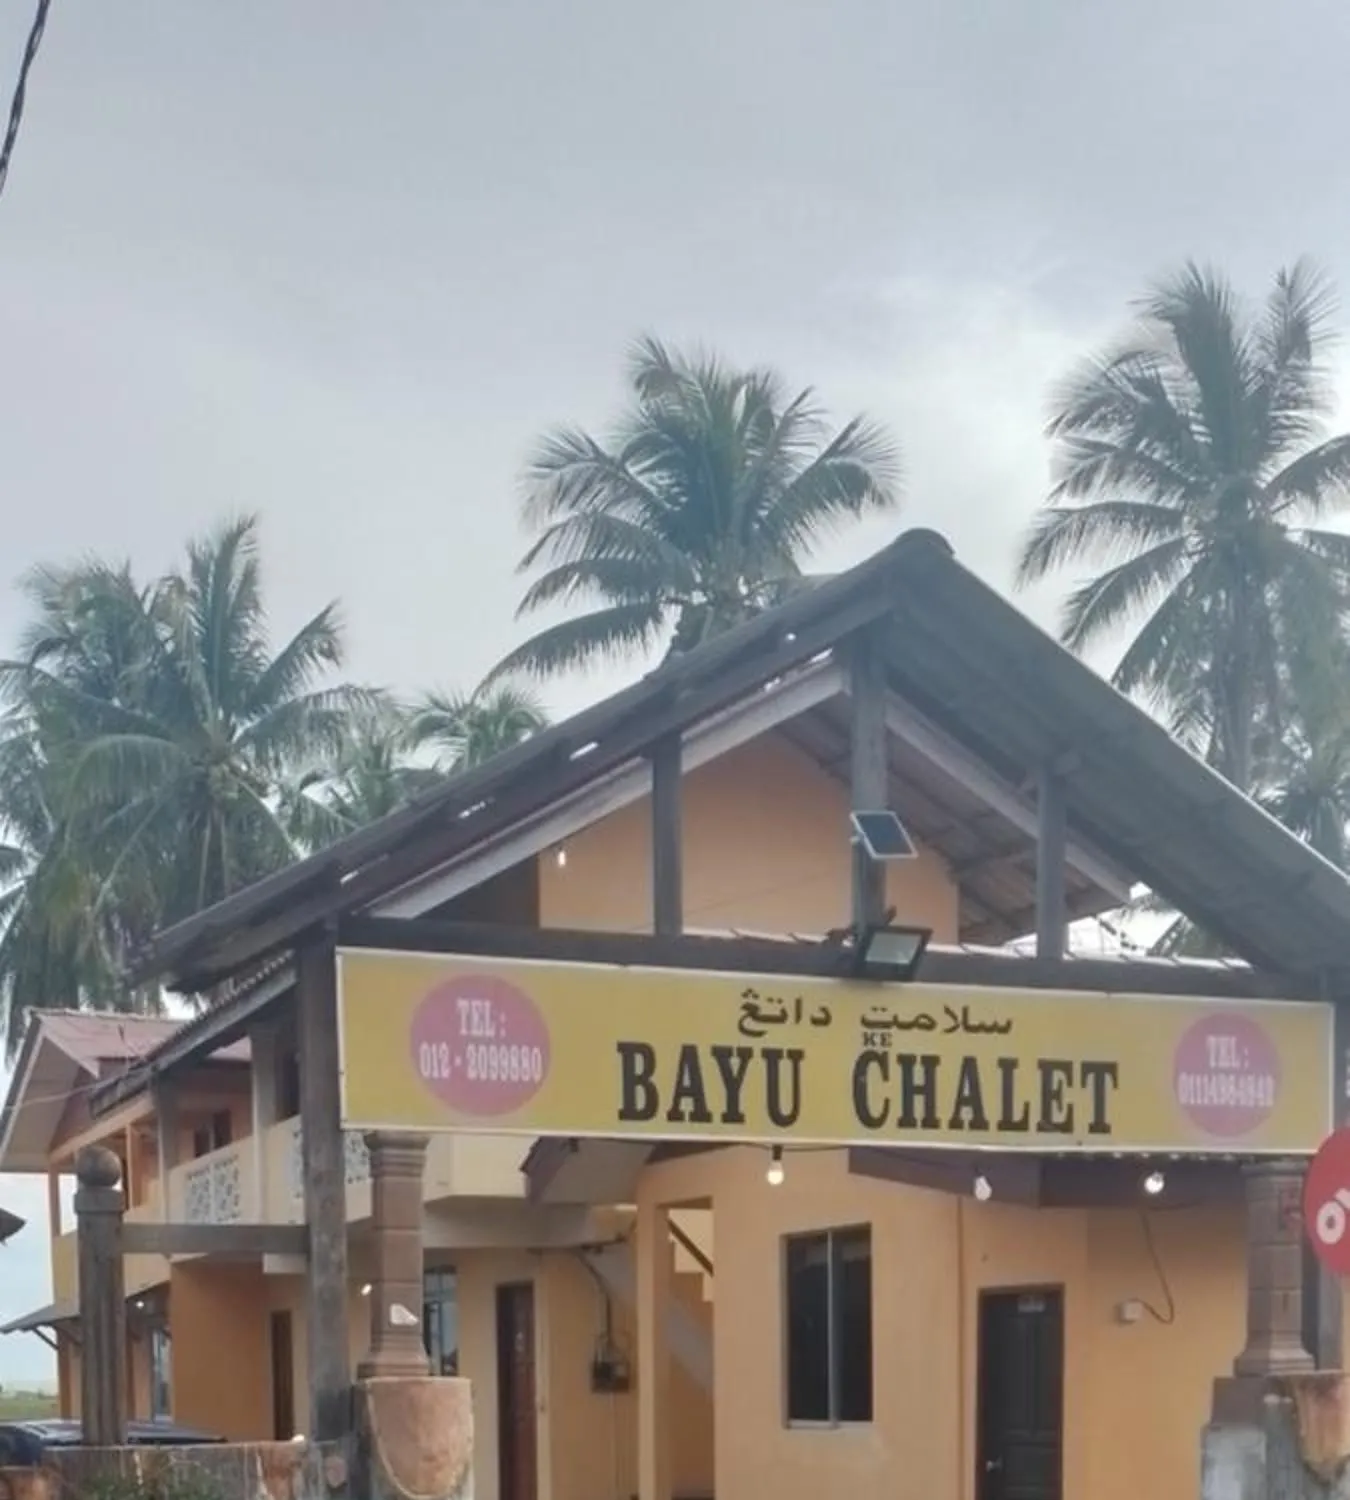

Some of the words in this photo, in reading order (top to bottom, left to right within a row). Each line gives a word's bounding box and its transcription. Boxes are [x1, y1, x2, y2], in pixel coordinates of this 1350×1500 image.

[860, 1004, 1014, 1035] سلامت
[861, 1031, 893, 1047] KE
[616, 1041, 805, 1128] BAYU
[852, 1047, 1119, 1134] CHALET
